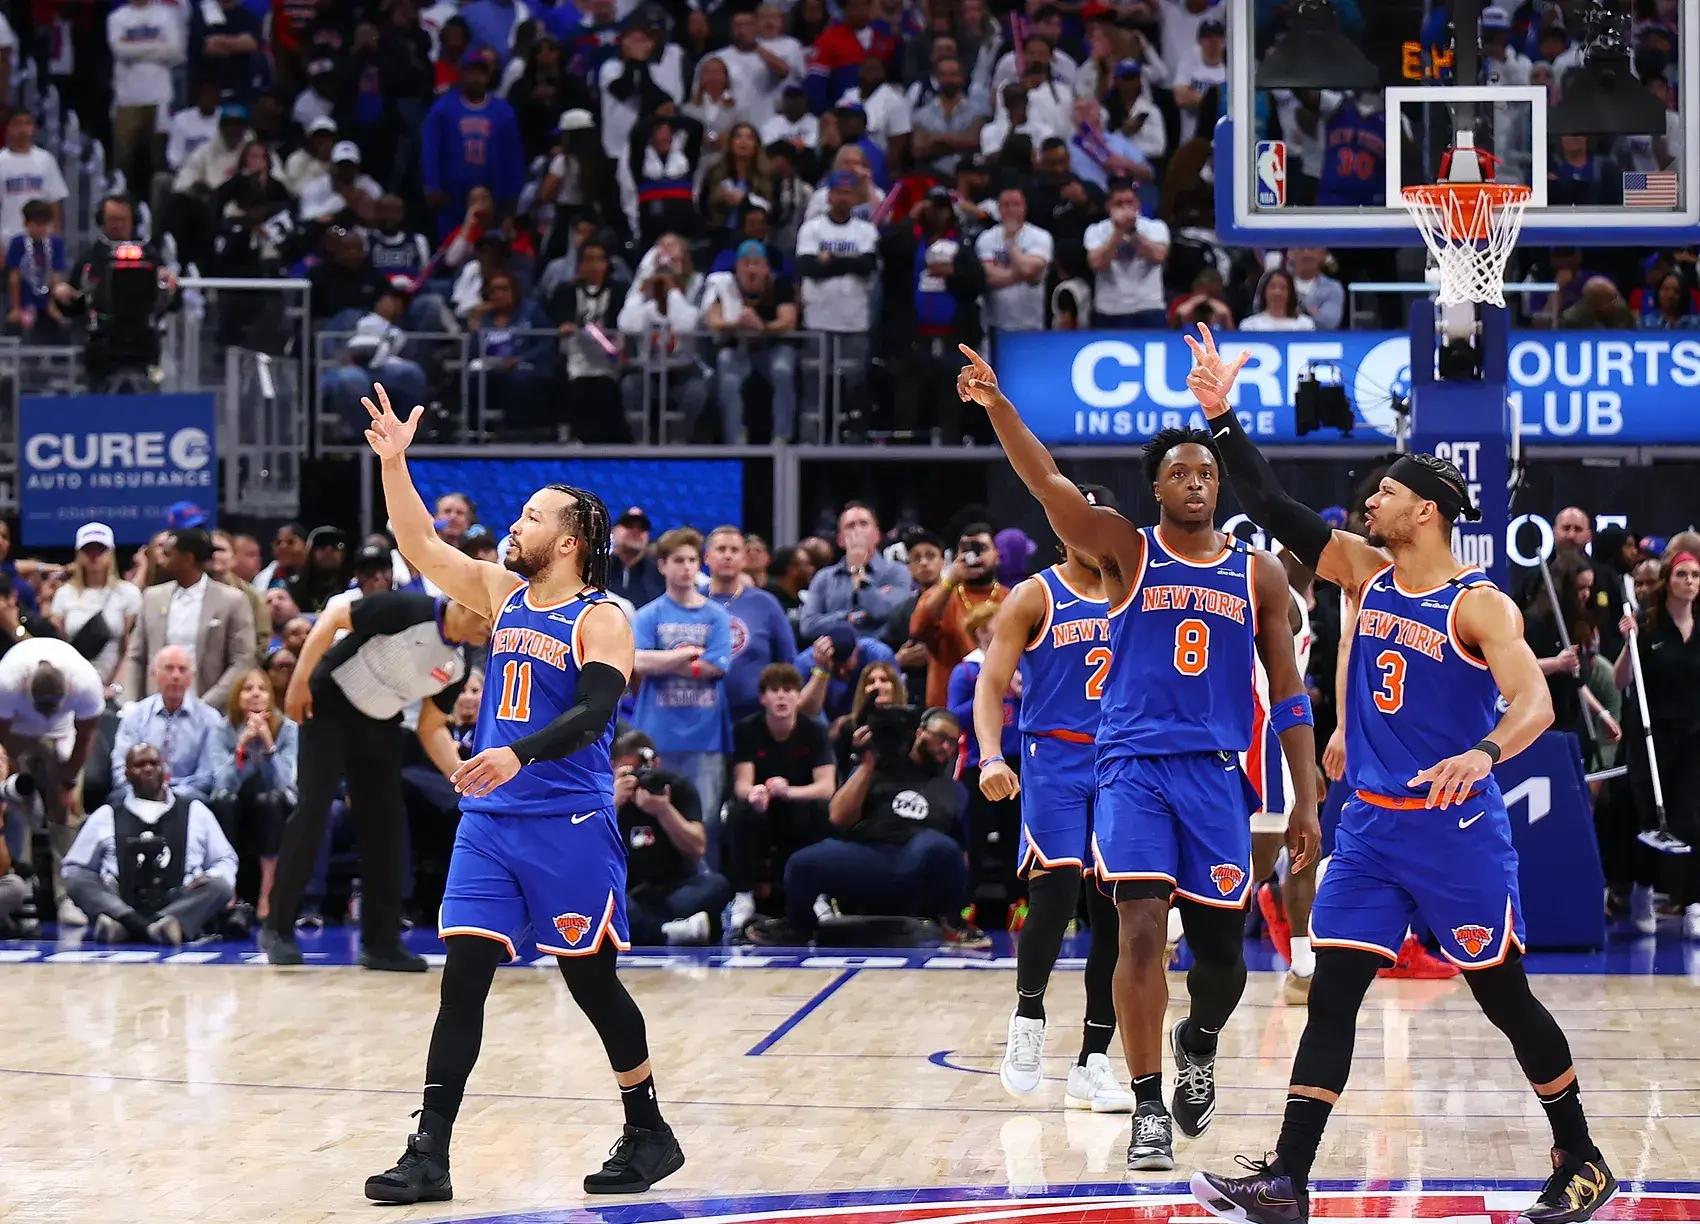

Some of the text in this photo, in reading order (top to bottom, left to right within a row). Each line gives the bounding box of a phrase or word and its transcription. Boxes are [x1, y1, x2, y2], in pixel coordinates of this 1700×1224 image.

[1508, 340, 1700, 388] OURTS
[1074, 410, 1276, 436] INSURACE
[1509, 390, 1624, 436] LUB
[25, 432, 166, 470] CURE
[27, 470, 211, 490] AUTO INSURANCE
[1142, 585, 1247, 625] NEW YORK
[1173, 618, 1211, 677] 8
[496, 660, 532, 722] 11
[1085, 647, 1113, 700] 2
[1373, 650, 1408, 714] 3
